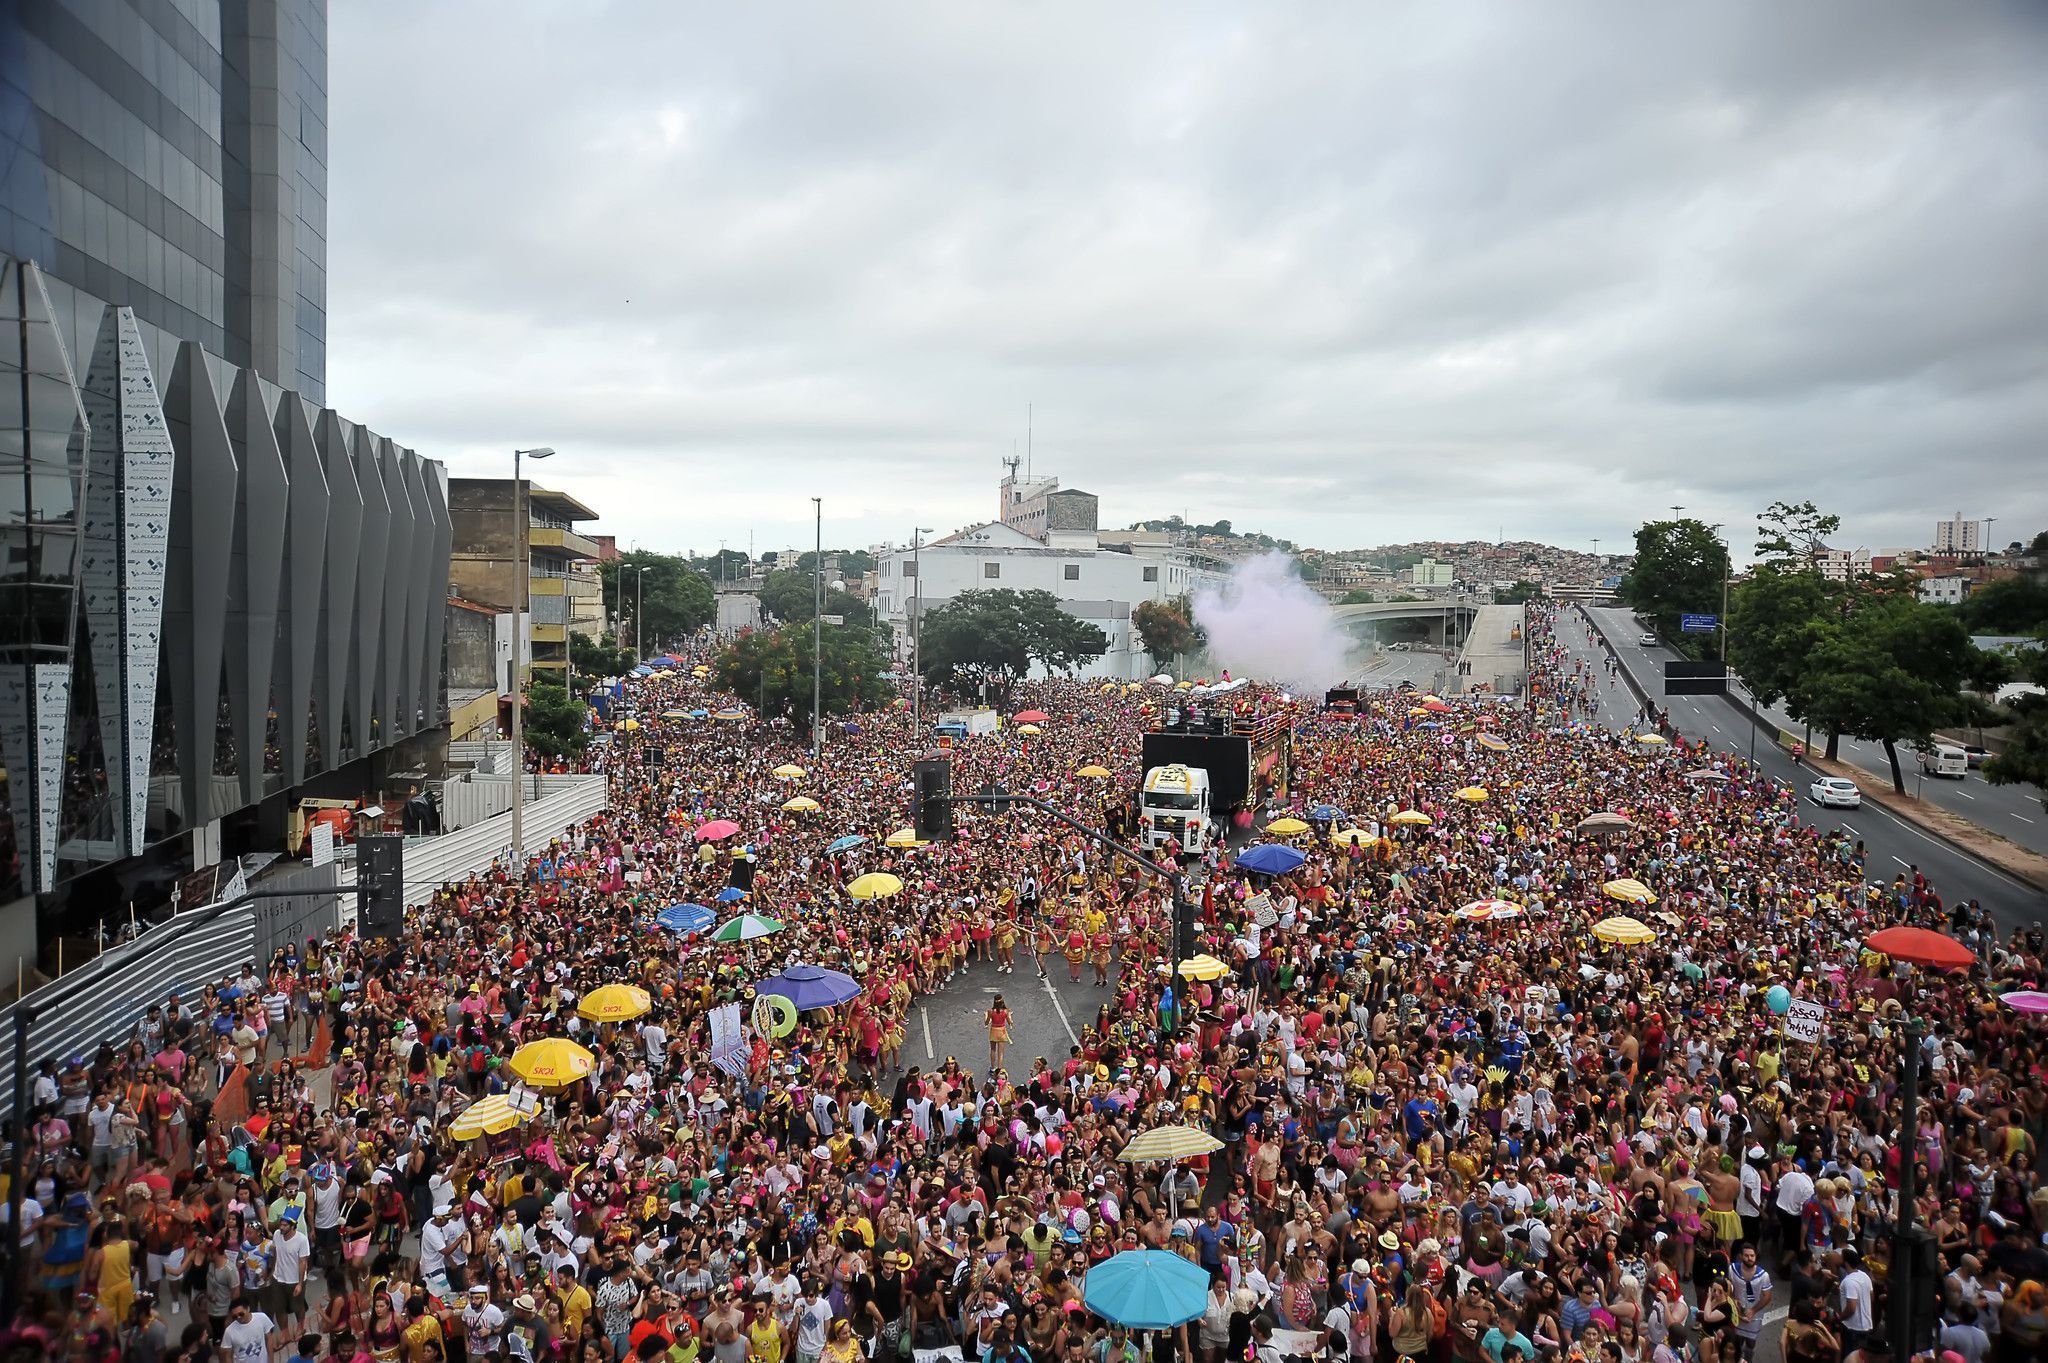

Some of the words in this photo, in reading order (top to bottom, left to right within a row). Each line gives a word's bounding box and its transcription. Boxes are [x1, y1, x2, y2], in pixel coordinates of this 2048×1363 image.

[603, 1005, 623, 1013] SKOL
[1790, 1006, 1822, 1022] PASSOU
[1787, 1017, 1819, 1036] BRILHOU
[532, 1066, 554, 1075] SKOL
